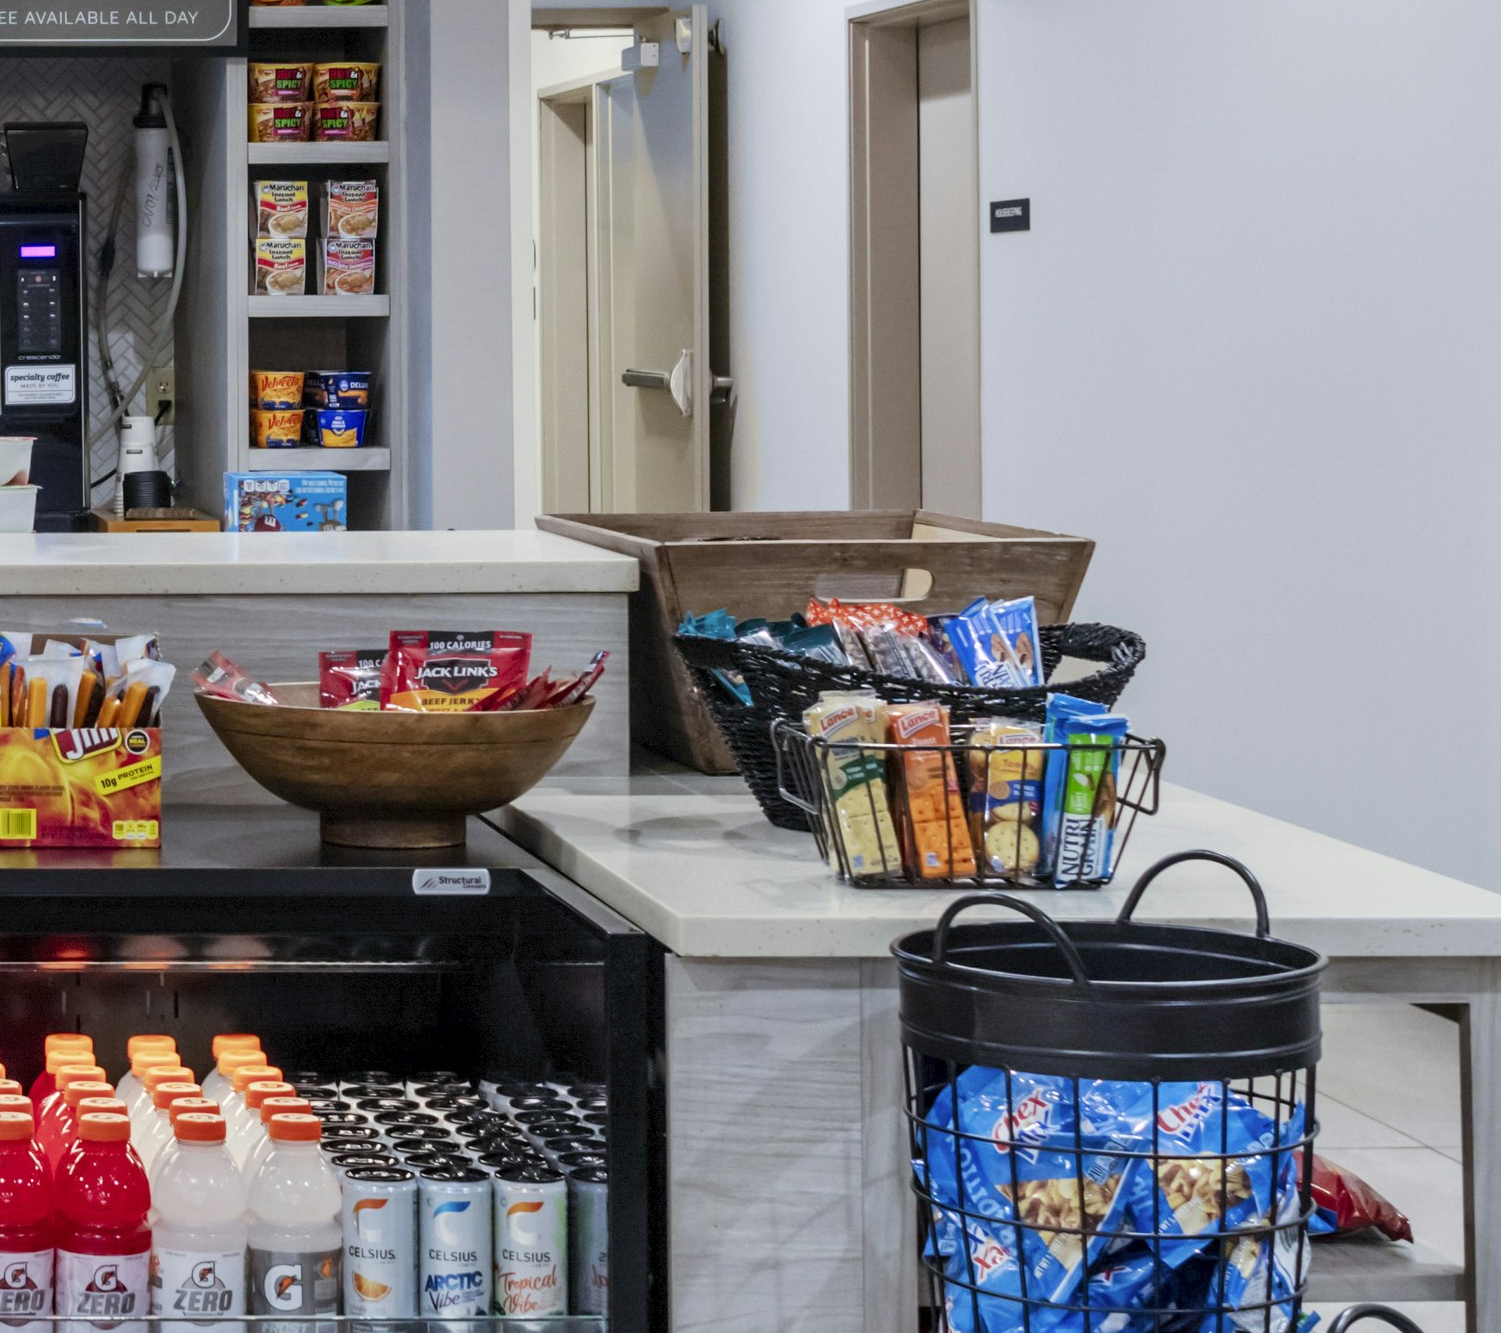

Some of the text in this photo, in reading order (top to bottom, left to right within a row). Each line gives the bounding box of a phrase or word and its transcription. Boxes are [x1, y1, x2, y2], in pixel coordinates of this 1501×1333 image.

[23, 10, 120, 26] AVAILABLE
[126, 10, 159, 26] ALL
[165, 10, 199, 26] DAY
[269, 184, 304, 192] Maruchan
[10, 372, 70, 383] specialty coffee
[430, 640, 492, 650] 100 CALORIES
[414, 666, 451, 679] JACK
[421, 698, 447, 706] BEEF
[820, 705, 856, 732] Lance
[900, 708, 937, 731] Lance
[100, 777, 118, 789] 10g
[118, 763, 154, 781] PROTEIN
[1061, 818, 1080, 878] NUTRI
[438, 876, 483, 886] Structural
[994, 1090, 1048, 1153] Chex
[348, 1245, 396, 1260] CELSIUS
[428, 1249, 478, 1262] CELSIUS
[502, 1249, 551, 1262] CELSIUS
[263, 1263, 304, 1311] G
[424, 1271, 483, 1292] ARCTIC
[500, 1265, 558, 1290] Tropical
[77, 1291, 136, 1315] ZERO
[173, 1289, 233, 1312] ZERO
[428, 1290, 460, 1312] Vibe
[503, 1293, 539, 1313] Vibe
